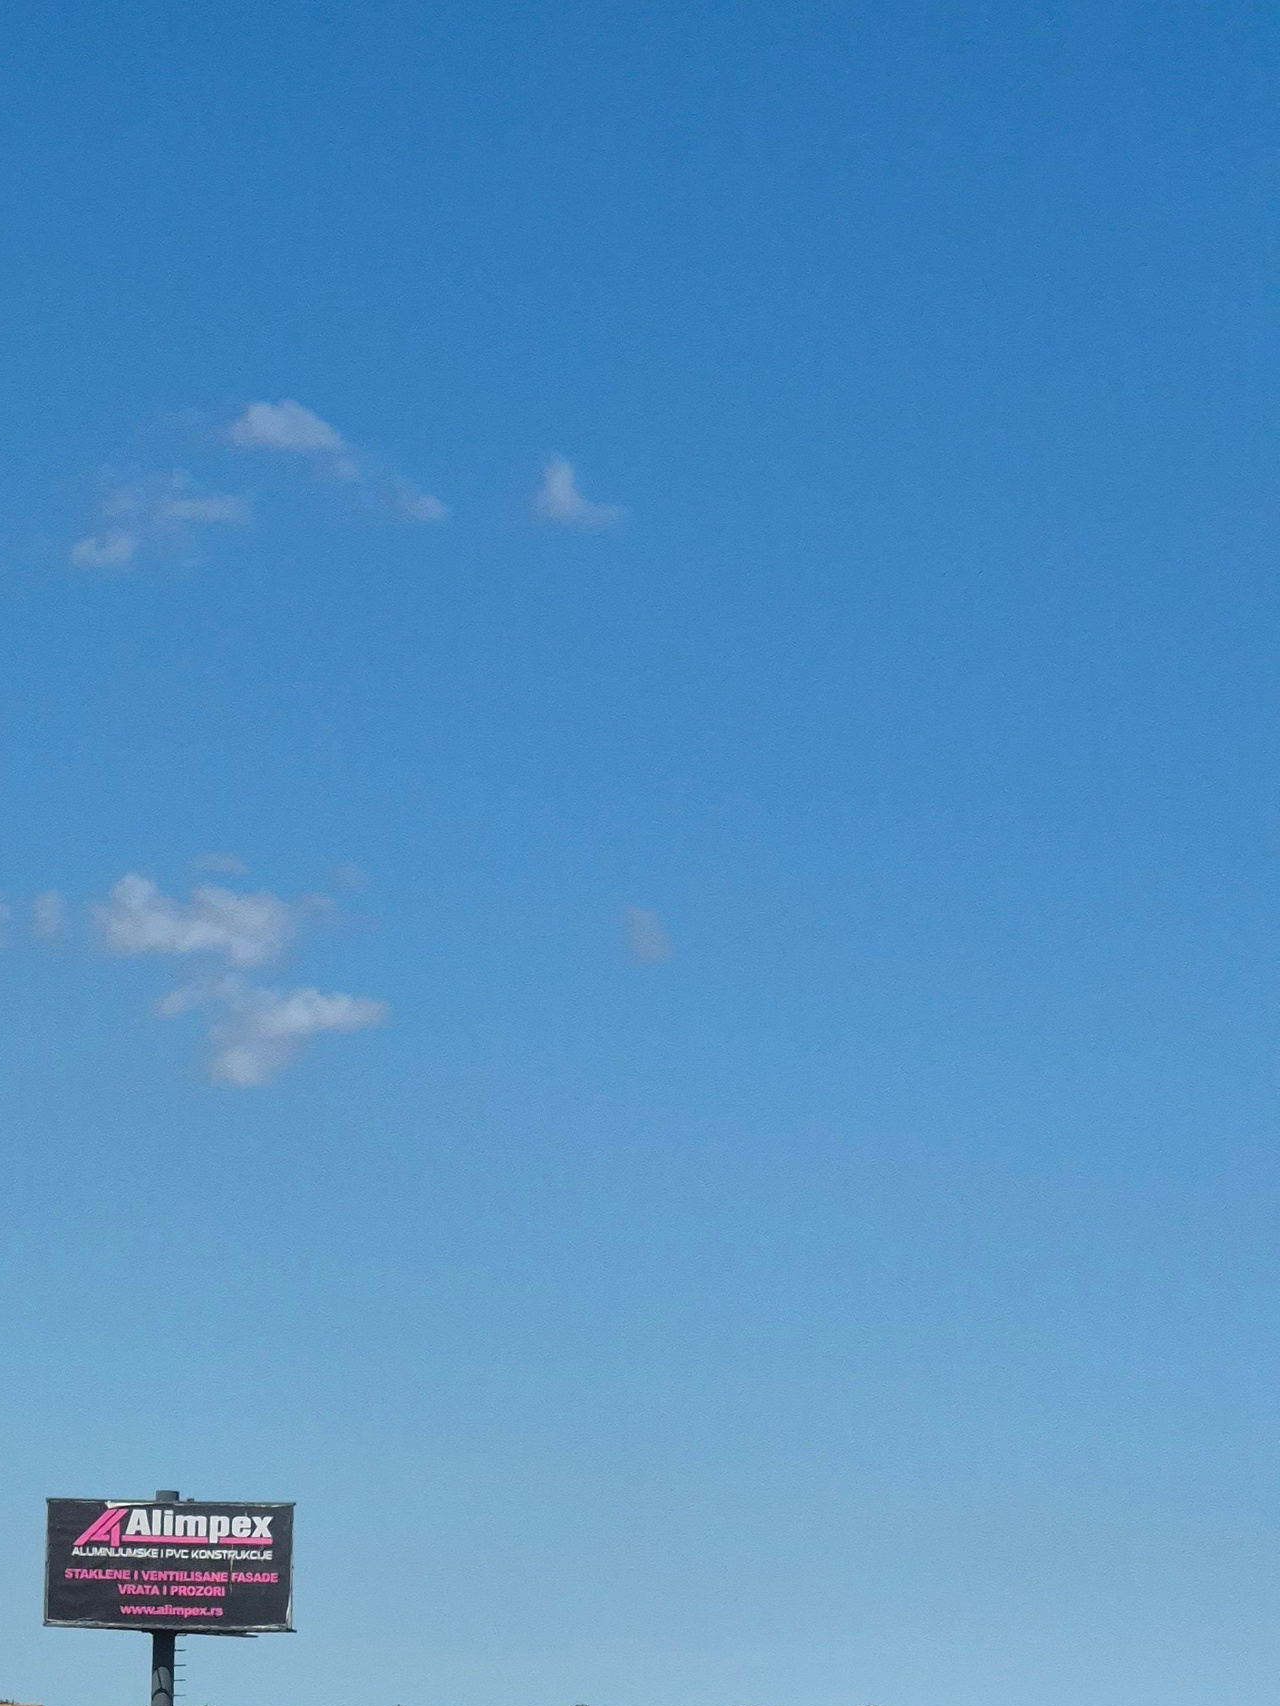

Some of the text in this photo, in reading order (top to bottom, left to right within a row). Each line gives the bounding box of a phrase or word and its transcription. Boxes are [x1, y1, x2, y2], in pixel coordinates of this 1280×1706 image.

[125, 1509, 273, 1543] Alimpex
[165, 1549, 189, 1559] PVC
[191, 1550, 273, 1560] KONSTRUKCIJE
[64, 1568, 131, 1580] STAKLENE
[231, 1572, 278, 1583] FASADE
[118, 1584, 160, 1595] VRATA
[170, 1585, 226, 1597] PROZORI
[120, 1604, 223, 1618] www.alimpex.rs
